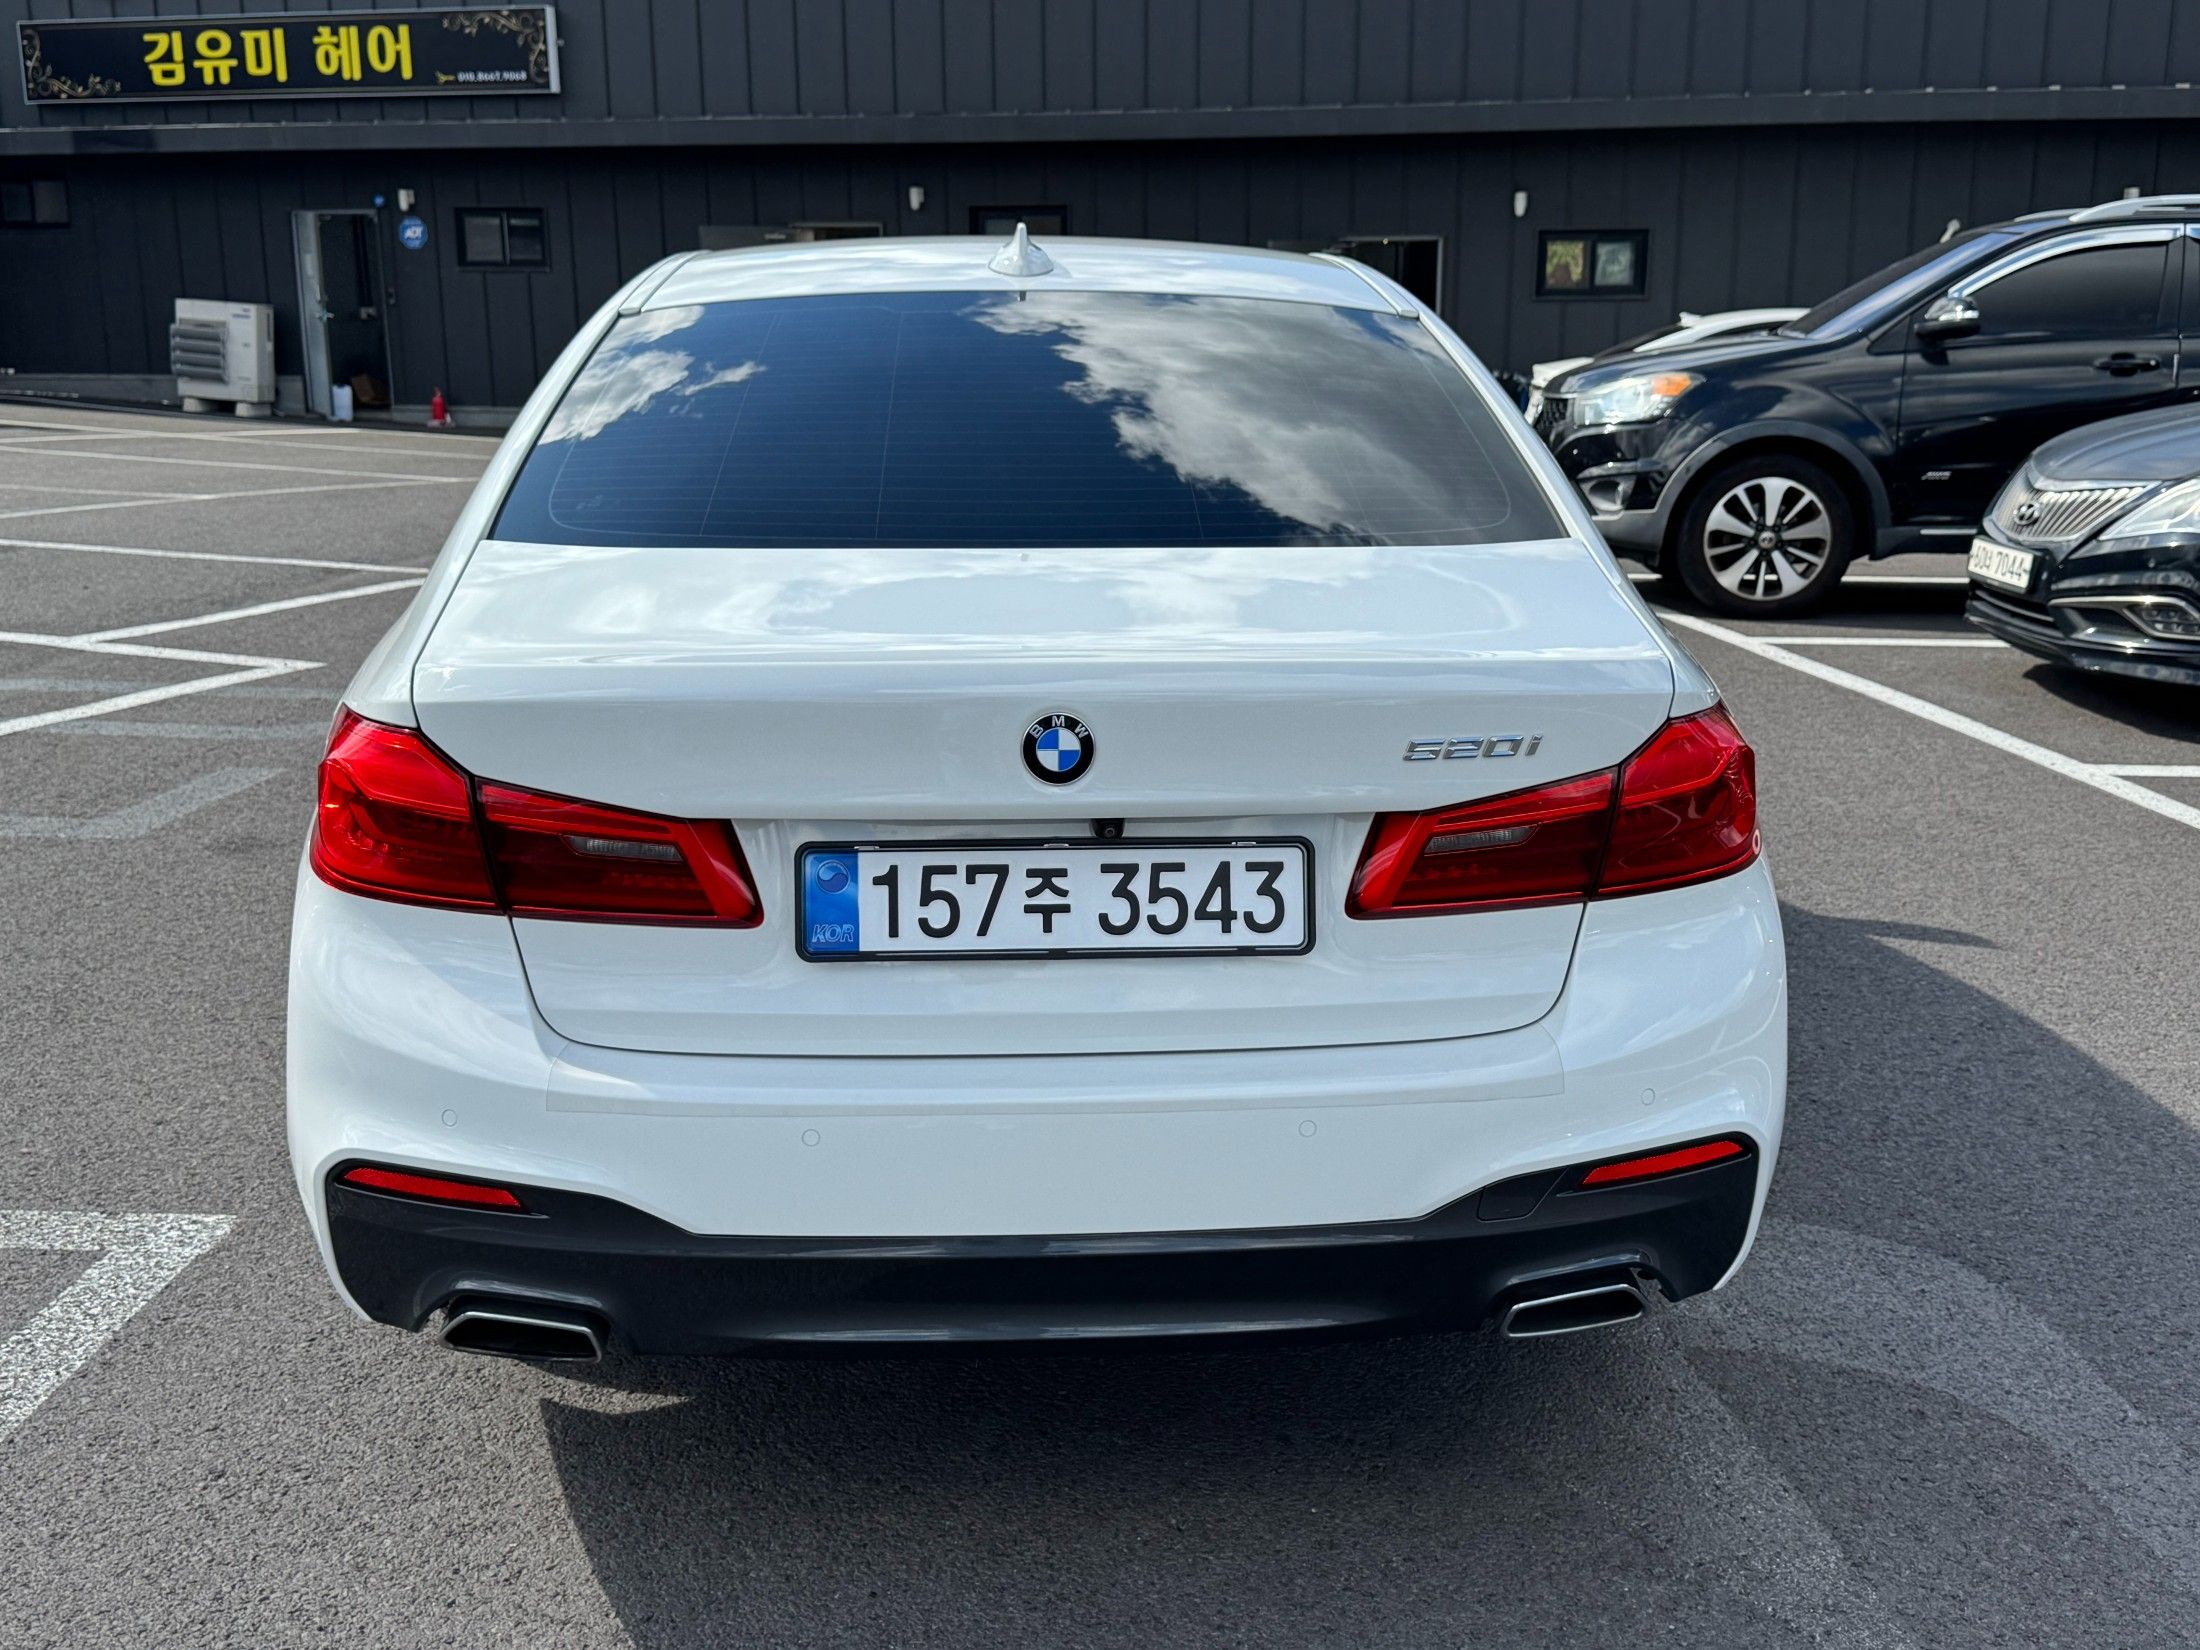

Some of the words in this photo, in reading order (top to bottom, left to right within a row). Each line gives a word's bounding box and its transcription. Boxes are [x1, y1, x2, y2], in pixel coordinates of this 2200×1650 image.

[143, 27, 288, 86] 김유미
[312, 24, 413, 81] 헤어
[1994, 551, 2024, 581] 7044
[1029, 715, 1089, 739] BMW
[1402, 734, 1543, 761] 520i
[872, 864, 1071, 938] 157주
[1098, 861, 1285, 935] 3543
[812, 923, 854, 943] KOR
